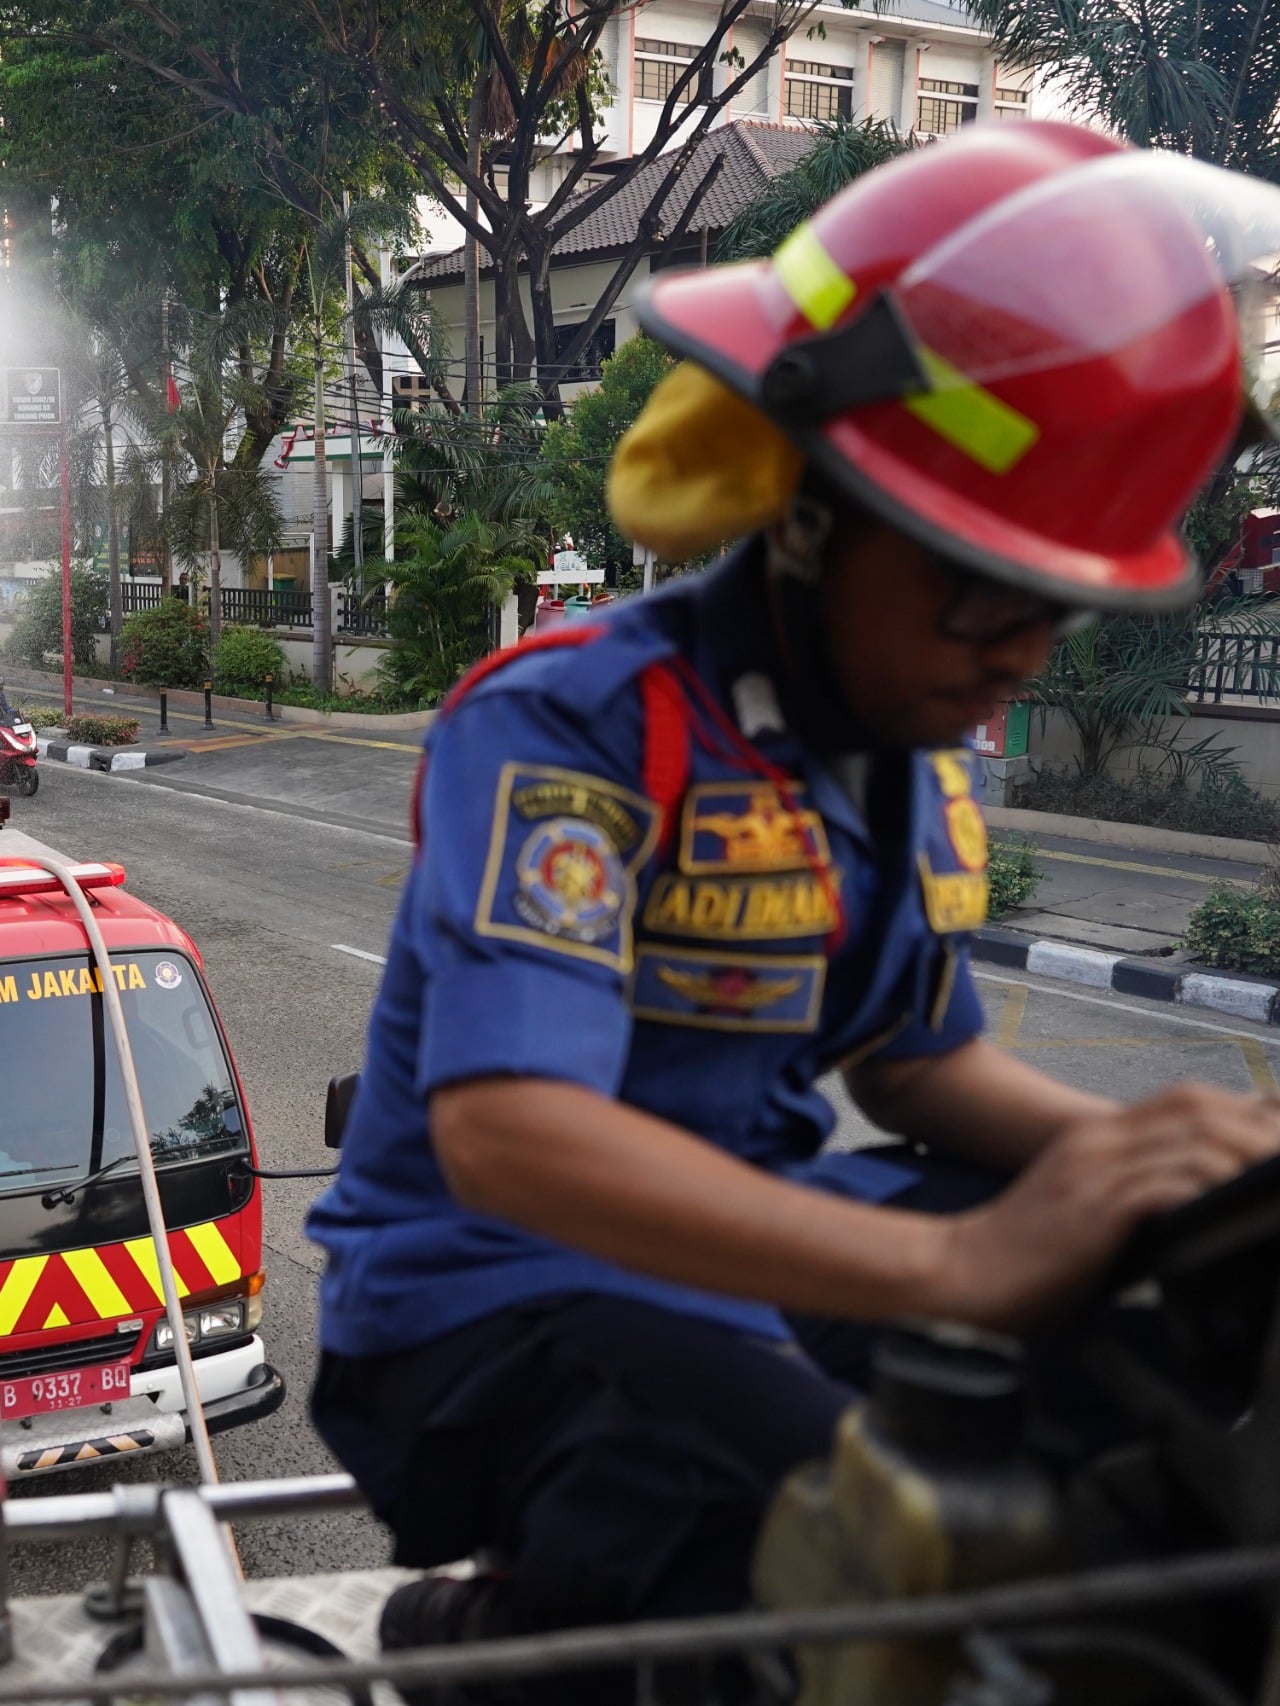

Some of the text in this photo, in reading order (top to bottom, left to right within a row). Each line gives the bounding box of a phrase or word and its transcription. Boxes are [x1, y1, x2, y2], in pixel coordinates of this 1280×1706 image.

[4, 1365, 128, 1407] B 9337 BQ
